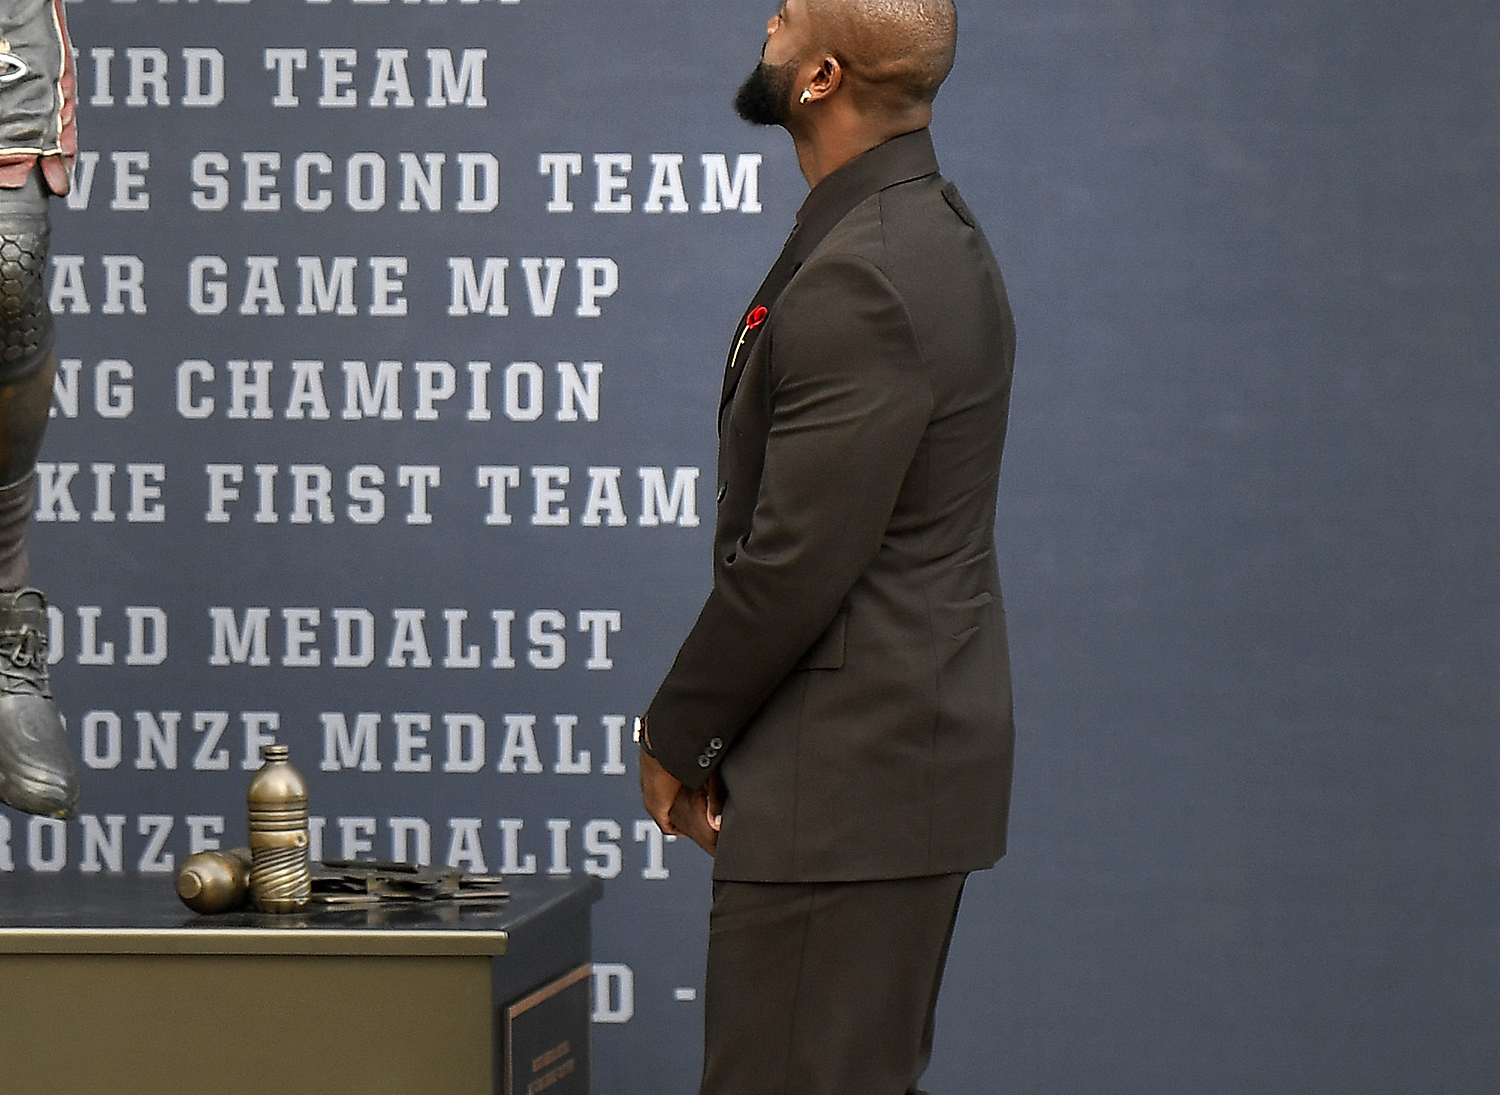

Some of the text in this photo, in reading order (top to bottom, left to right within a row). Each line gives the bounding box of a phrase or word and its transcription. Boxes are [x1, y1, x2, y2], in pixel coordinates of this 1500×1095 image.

[73, 47, 226, 108] IRD
[263, 48, 489, 109] TEAM
[191, 152, 500, 213] SECOND
[537, 152, 764, 216] TEAM
[188, 255, 409, 317] GAME
[446, 256, 620, 318] MVP
[176, 359, 605, 423] CHAMPION
[205, 463, 442, 526] FIRST
[476, 465, 701, 528] TEAM
[209, 607, 622, 671] MEDALIST
[60, 711, 281, 771] ONZE
[320, 712, 627, 776] MEDALI
[308, 816, 678, 881] EDALIST
